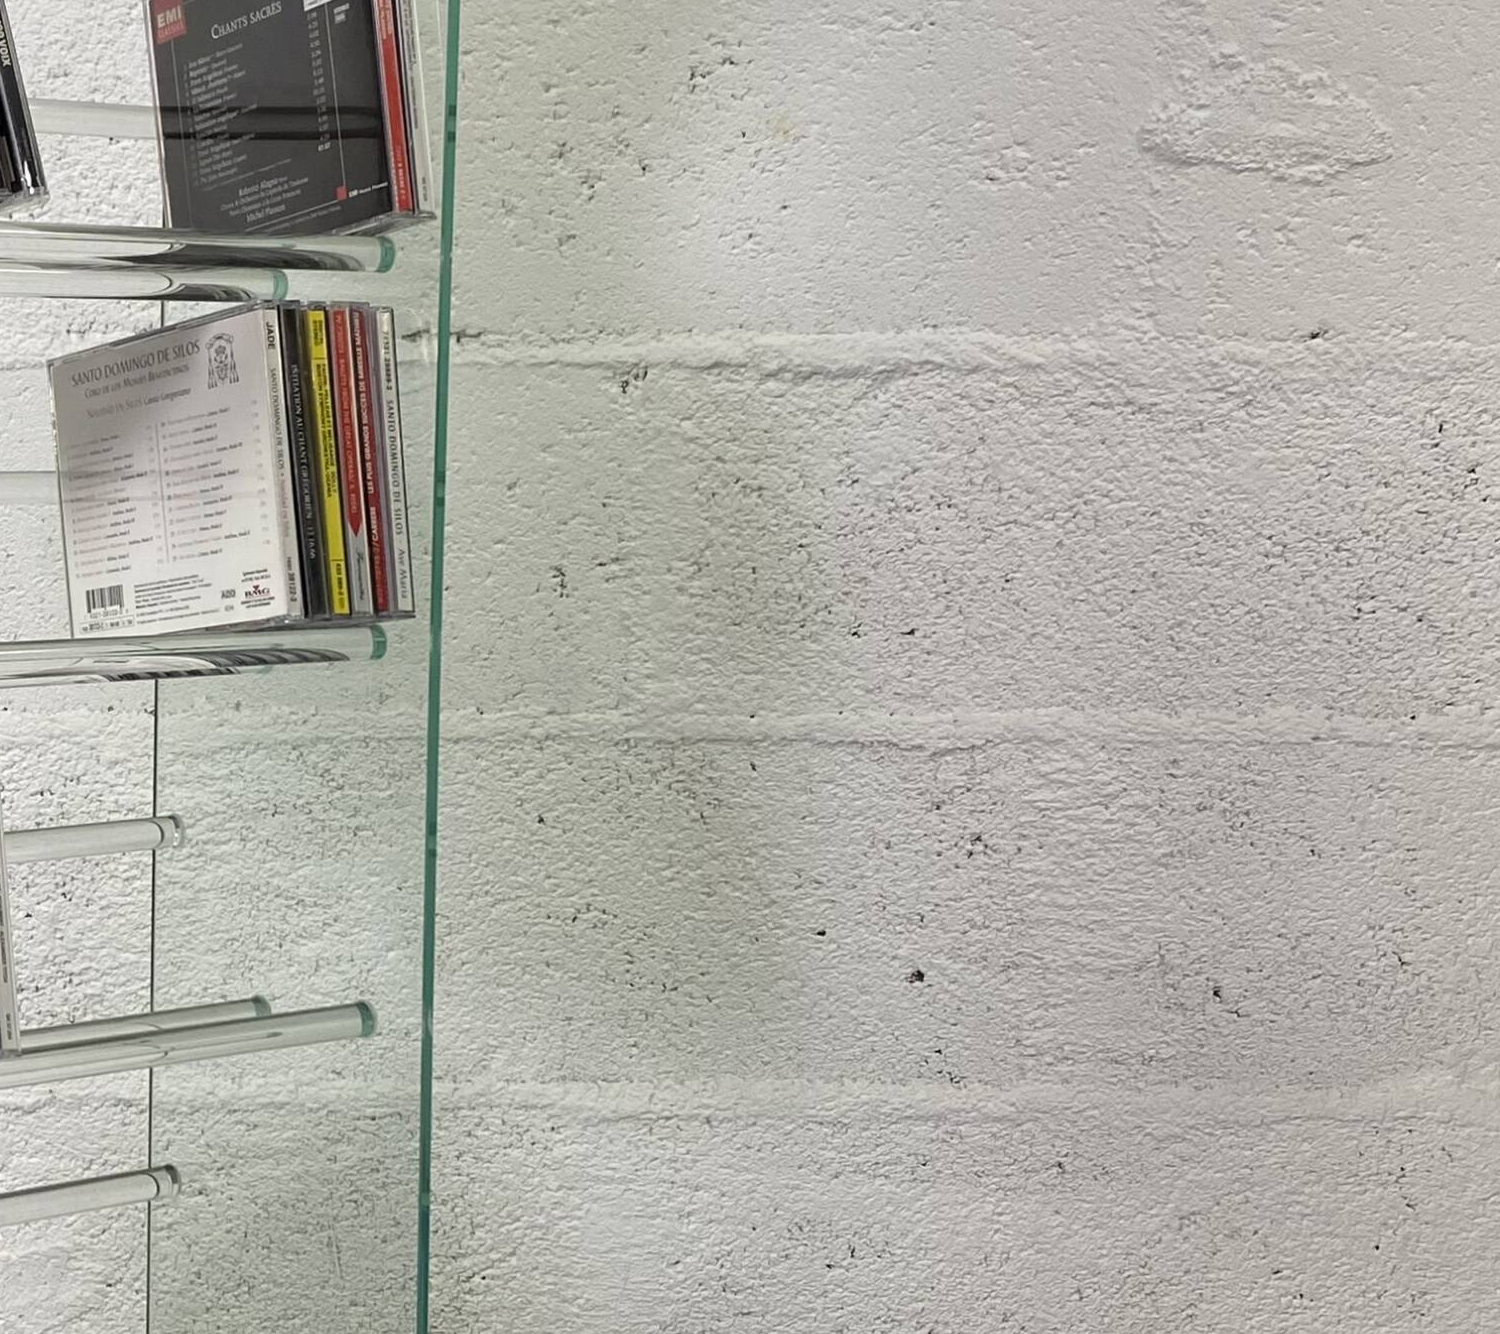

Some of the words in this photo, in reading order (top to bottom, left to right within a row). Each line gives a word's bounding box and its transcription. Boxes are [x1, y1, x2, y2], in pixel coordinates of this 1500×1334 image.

[157, 6, 182, 28] EMI
[265, 321, 275, 349] JADE
[71, 366, 102, 387] SANTO
[104, 352, 155, 378] DOMINGO
[172, 338, 200, 359] SILOS
[269, 367, 278, 393] SANTO
[290, 364, 302, 413] INITIATION
[271, 394, 281, 434] DOMINGO
[295, 416, 303, 429] AU
[385, 400, 395, 432] SANTO
[276, 448, 285, 469] SILOS
[297, 432, 306, 462] CHANT
[388, 436, 399, 487] DOMINGO
[393, 491, 400, 502] DE
[394, 507, 403, 535] SILOS
